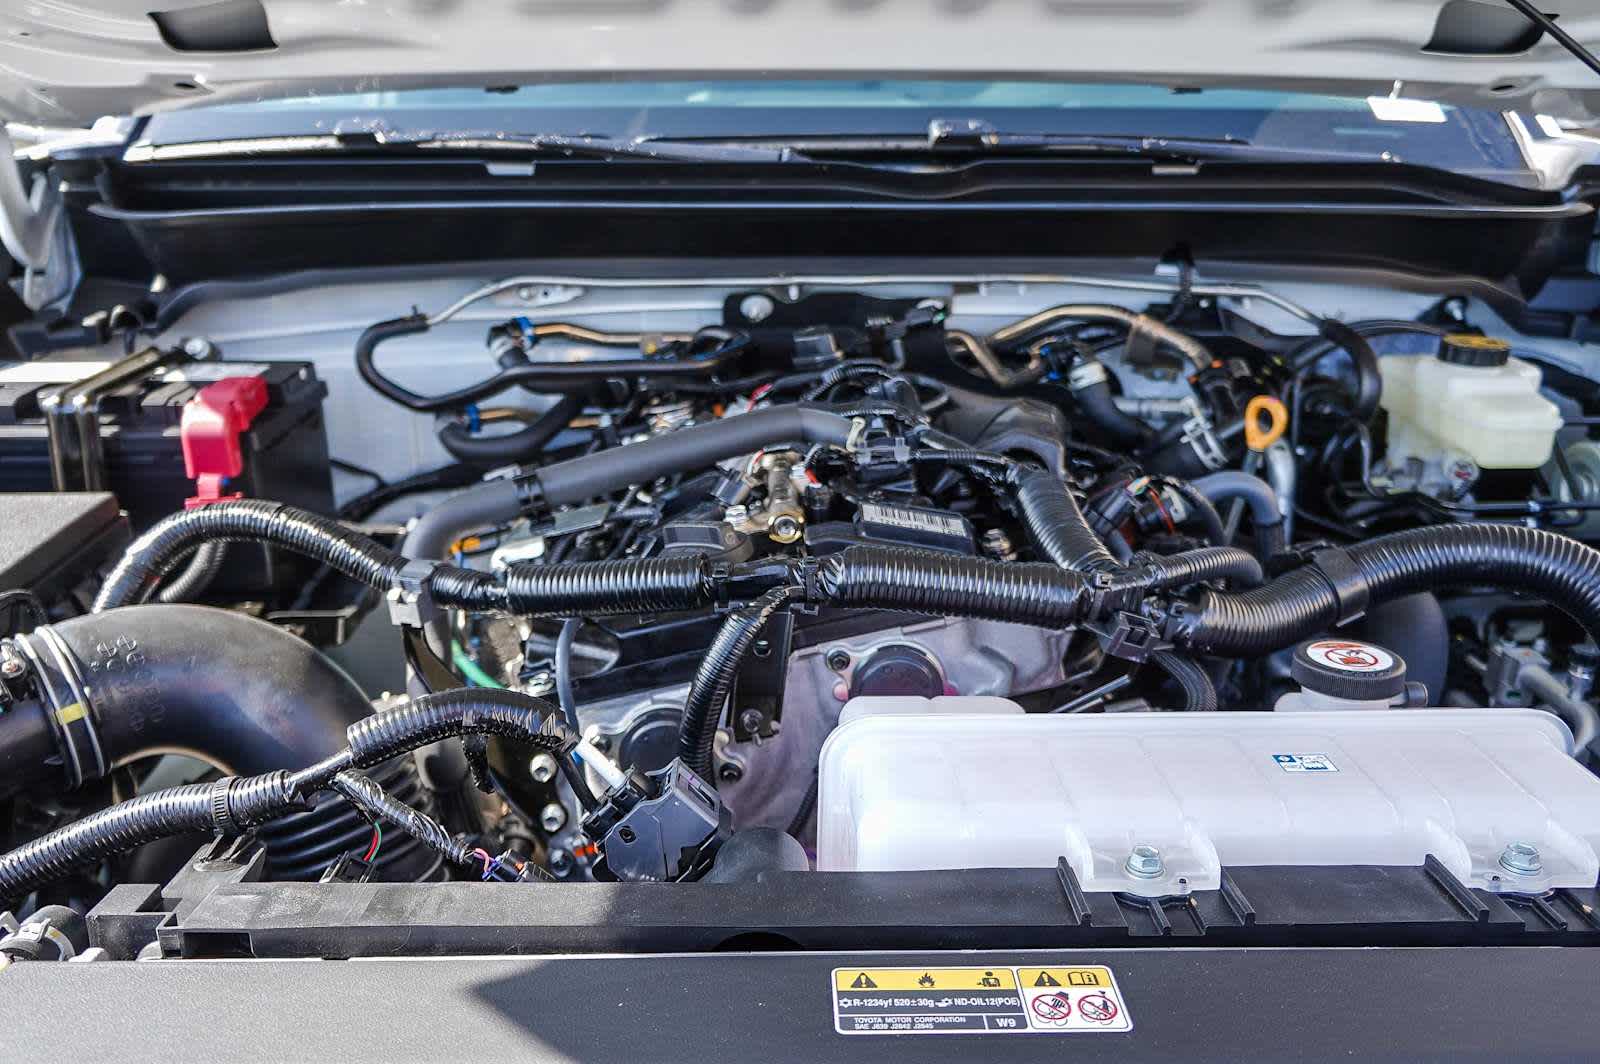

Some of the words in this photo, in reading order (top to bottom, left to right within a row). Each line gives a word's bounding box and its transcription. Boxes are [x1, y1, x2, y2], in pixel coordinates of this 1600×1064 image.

[853, 997, 893, 1008] R-1234yf
[954, 997, 1020, 1007] ND-OIL12(POE)
[996, 1018, 1017, 1028] W9
